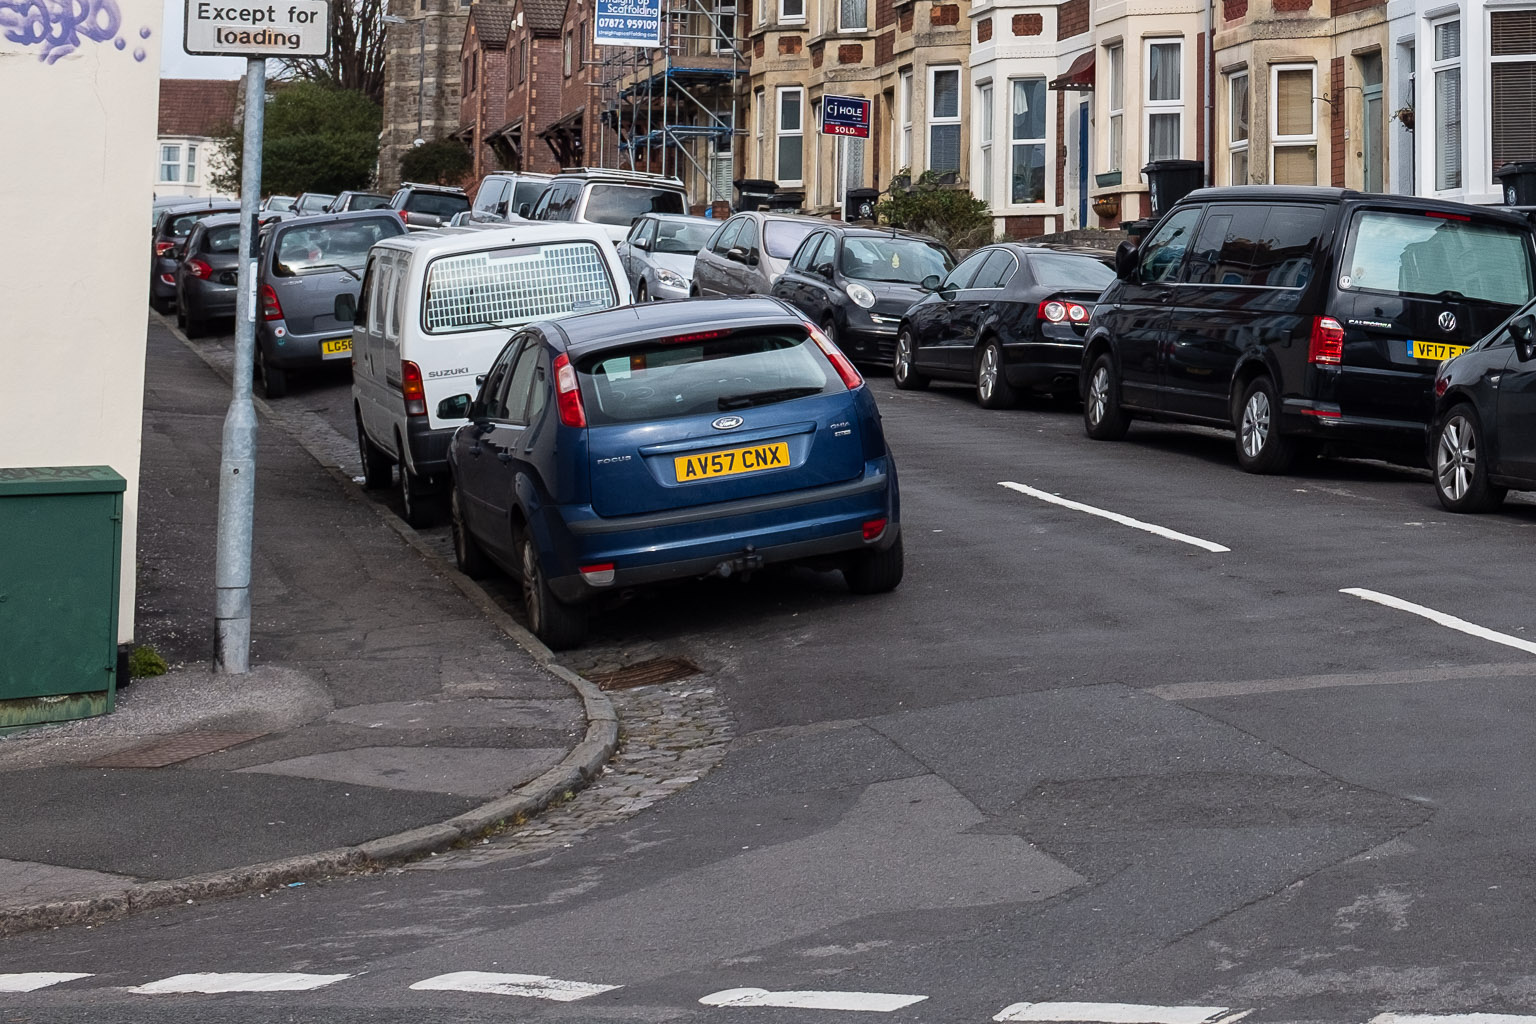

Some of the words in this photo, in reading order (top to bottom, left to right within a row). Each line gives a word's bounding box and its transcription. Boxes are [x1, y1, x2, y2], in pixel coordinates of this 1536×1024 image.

[197, 2, 276, 25] Except
[287, 6, 319, 24] for
[607, 3, 658, 18] Scaffolding
[598, 18, 625, 29] 07872
[626, 19, 658, 30] 959109
[216, 27, 301, 50] loading
[839, 106, 863, 117] HOLE
[835, 126, 855, 134] SOLD
[1418, 342, 1446, 358] VF17
[428, 367, 468, 377] SUZUKI
[597, 455, 632, 465] FOCUS
[685, 453, 736, 478] AV57
[741, 446, 783, 470] CNX
